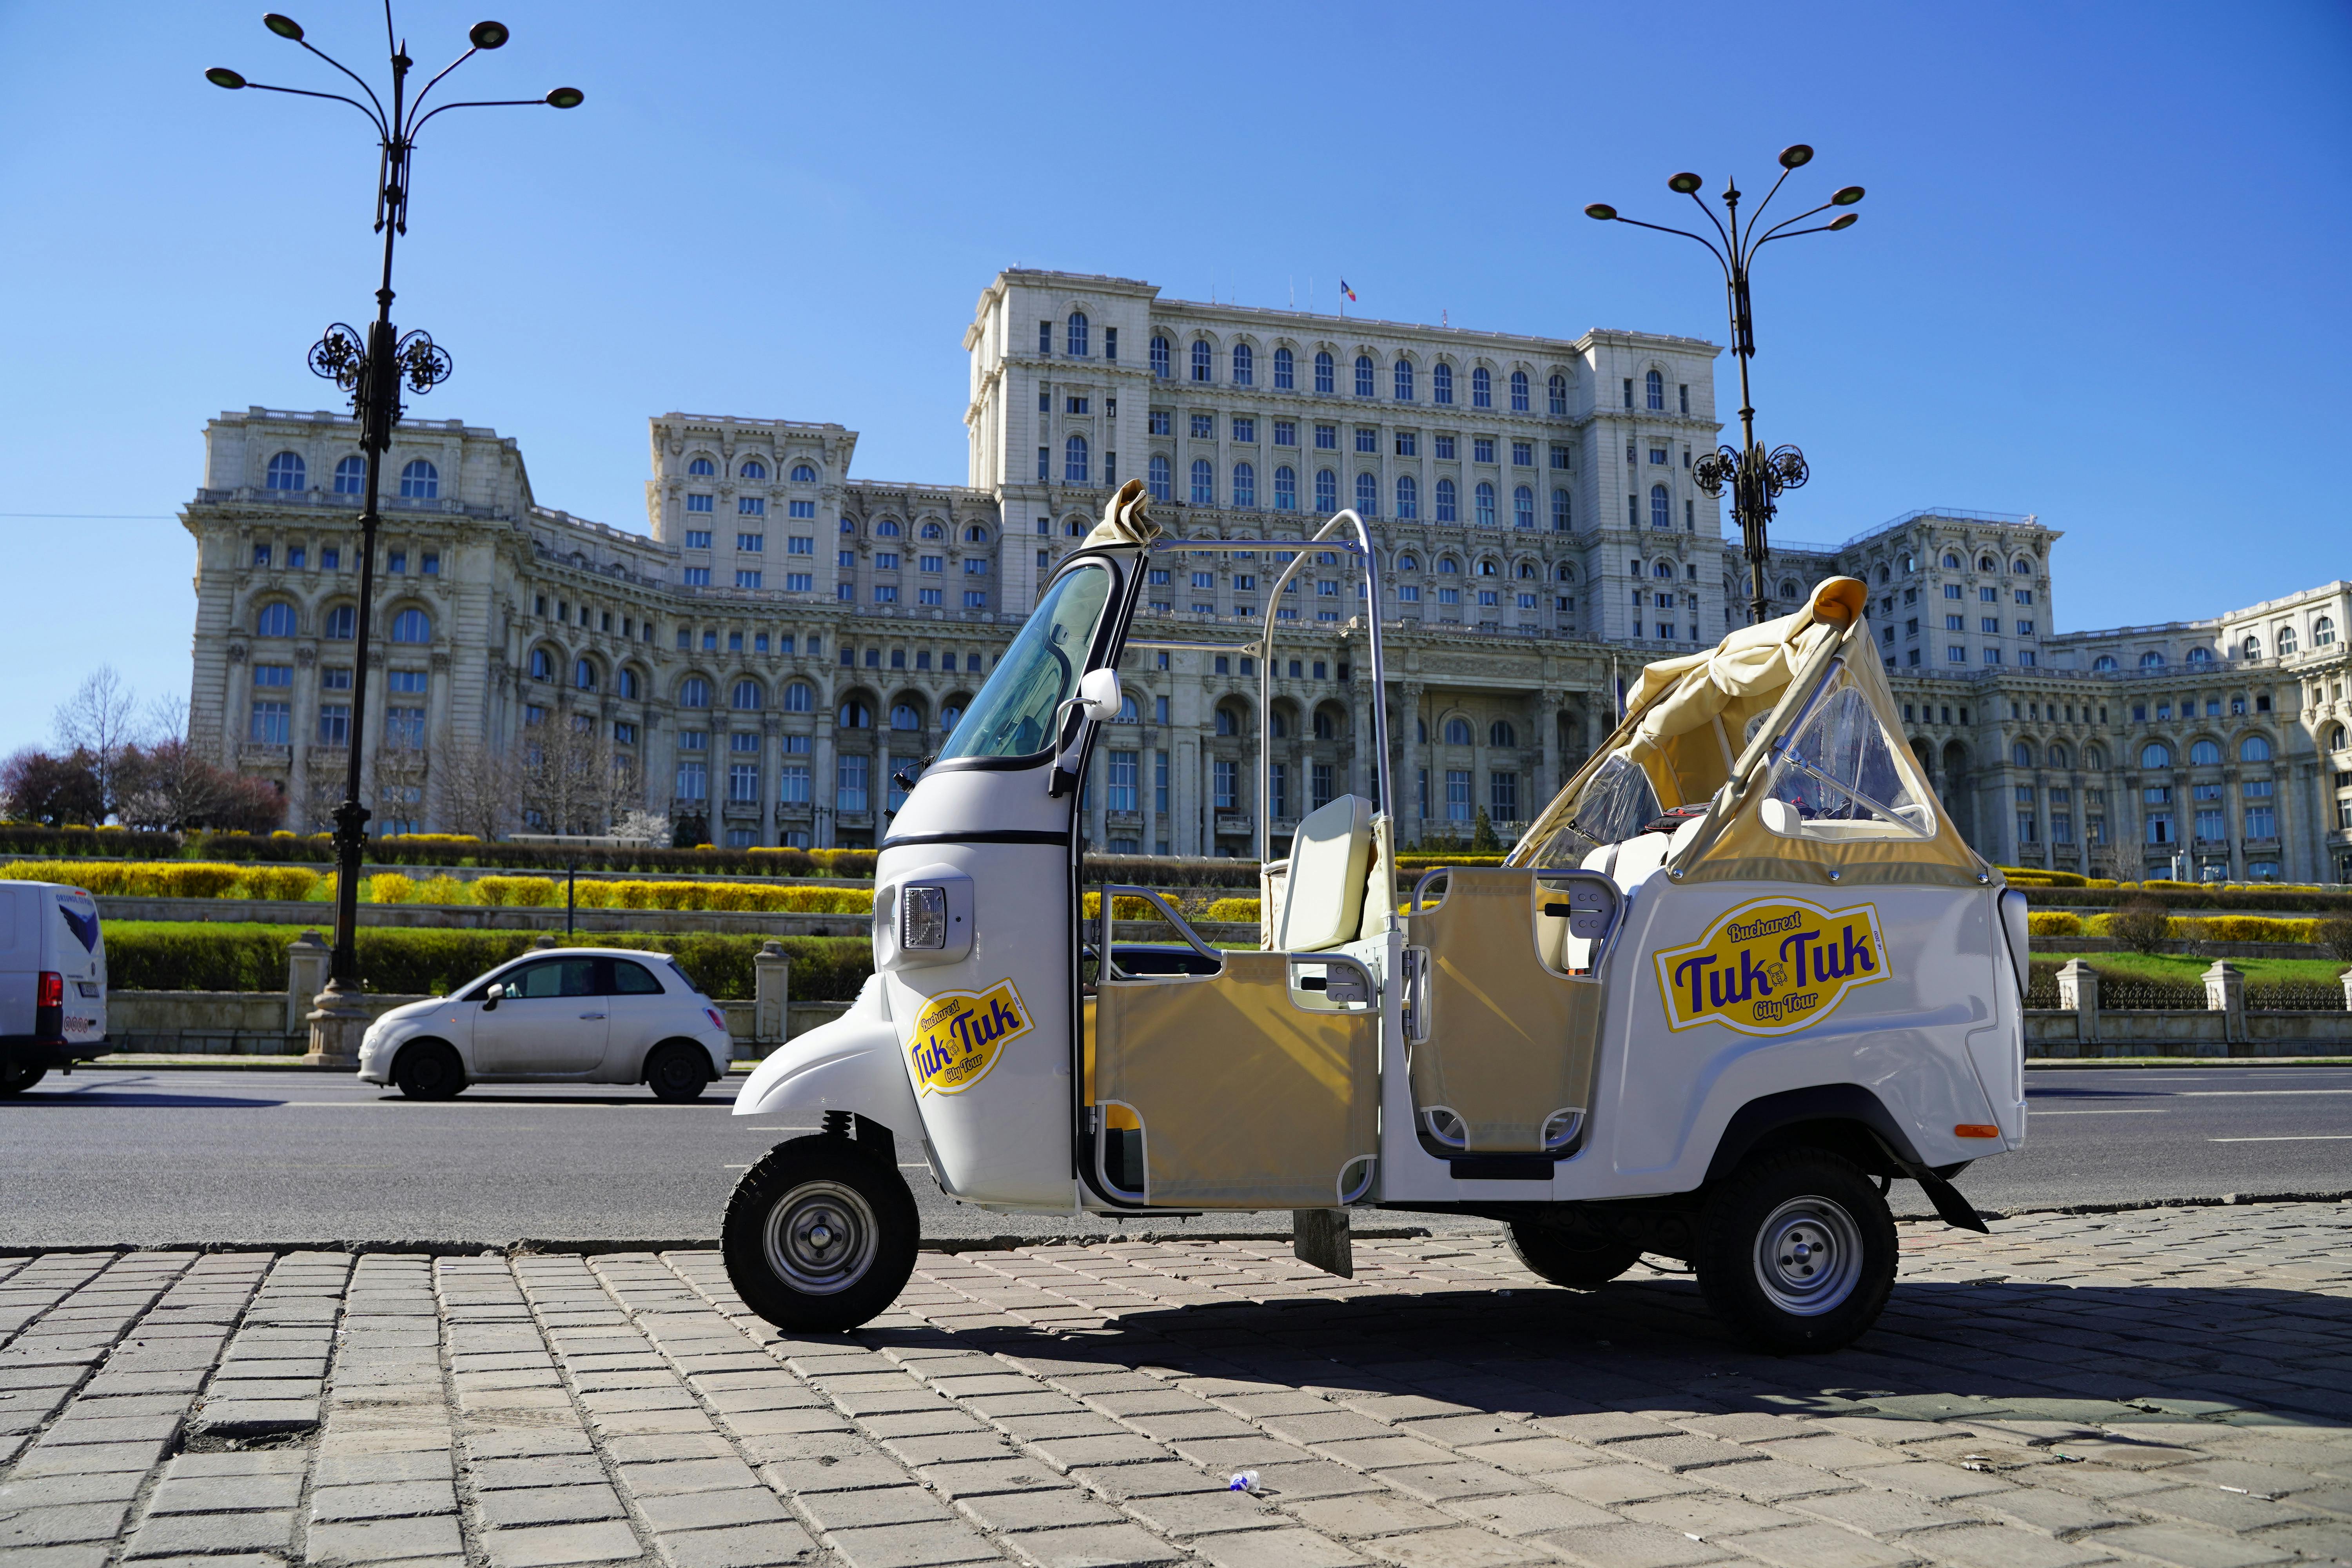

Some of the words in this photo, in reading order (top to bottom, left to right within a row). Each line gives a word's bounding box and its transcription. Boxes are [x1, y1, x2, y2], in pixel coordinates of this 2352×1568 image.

[1728, 911, 1801, 943] Bucharest
[1675, 949, 1773, 1013] Tuk
[1779, 925, 1875, 987] Tuk
[921, 999, 960, 1032] Bucharest
[1753, 1001, 1782, 1021] City
[1782, 992, 1818, 1013] Tour
[912, 1034, 952, 1083] Tuk
[950, 998, 1019, 1054] Tuk
[945, 1064, 962, 1083] City
[960, 1054, 982, 1073] Tour
